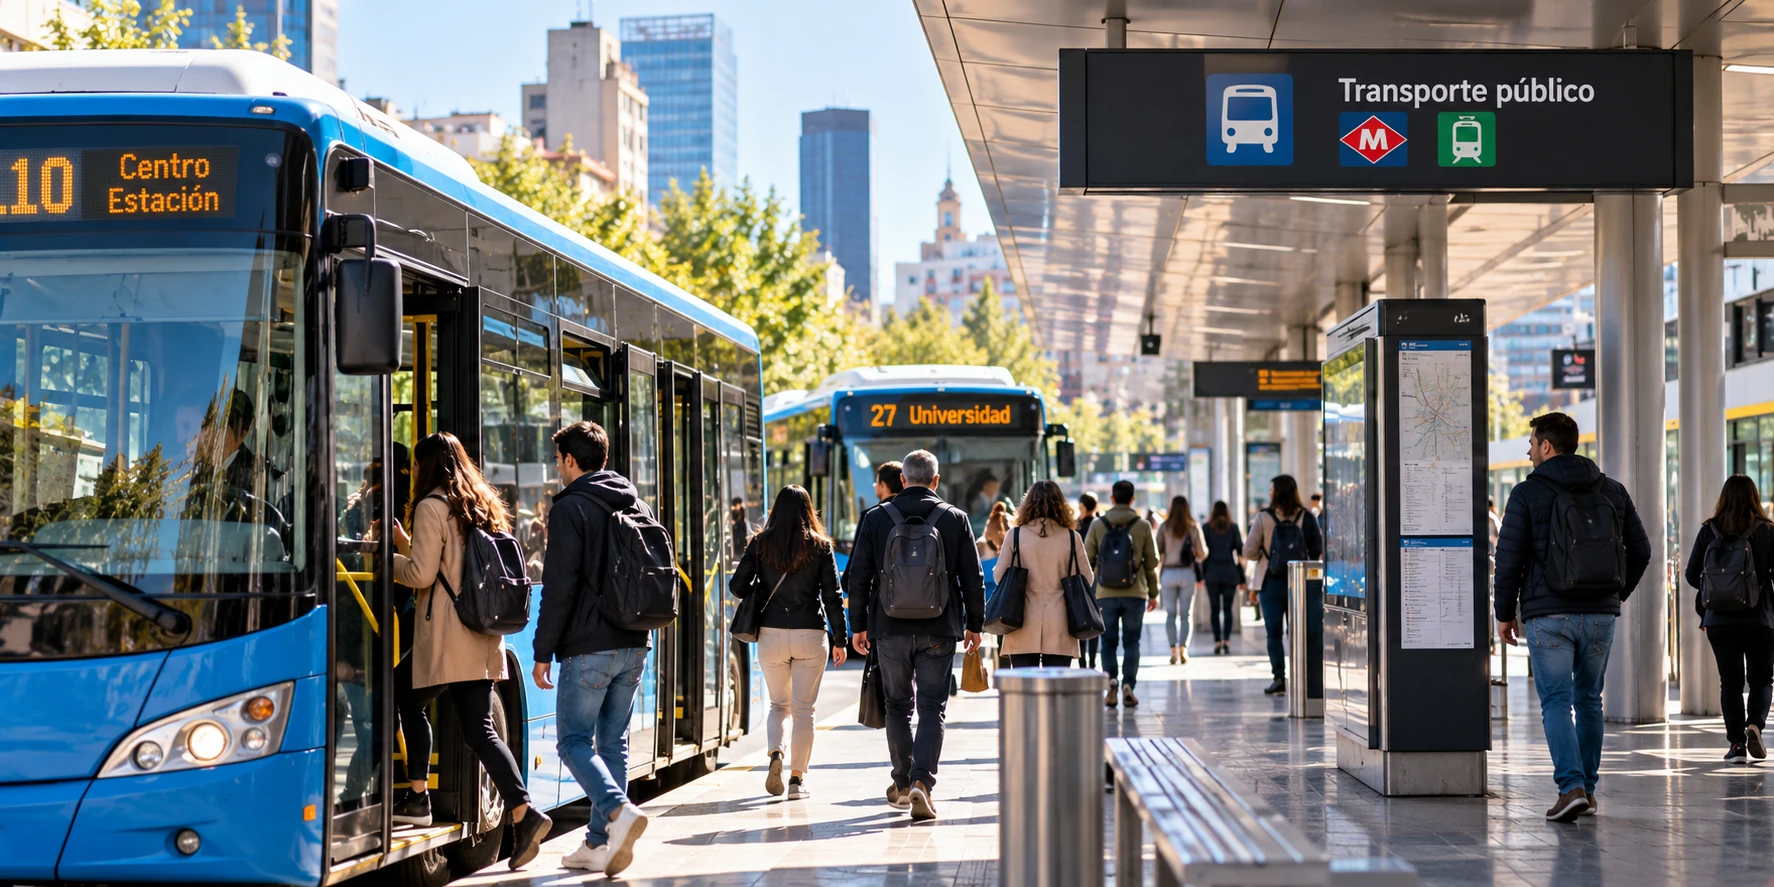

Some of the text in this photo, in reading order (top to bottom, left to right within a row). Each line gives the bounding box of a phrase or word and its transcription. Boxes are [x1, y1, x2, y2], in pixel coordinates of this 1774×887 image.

[1338, 77, 1595, 109] Transporte público
[1357, 128, 1389, 151] M
[119, 153, 210, 180] Centro
[0, 157, 73, 215] 10
[108, 185, 219, 214] Estación
[870, 403, 1011, 427] 27 Universidad
